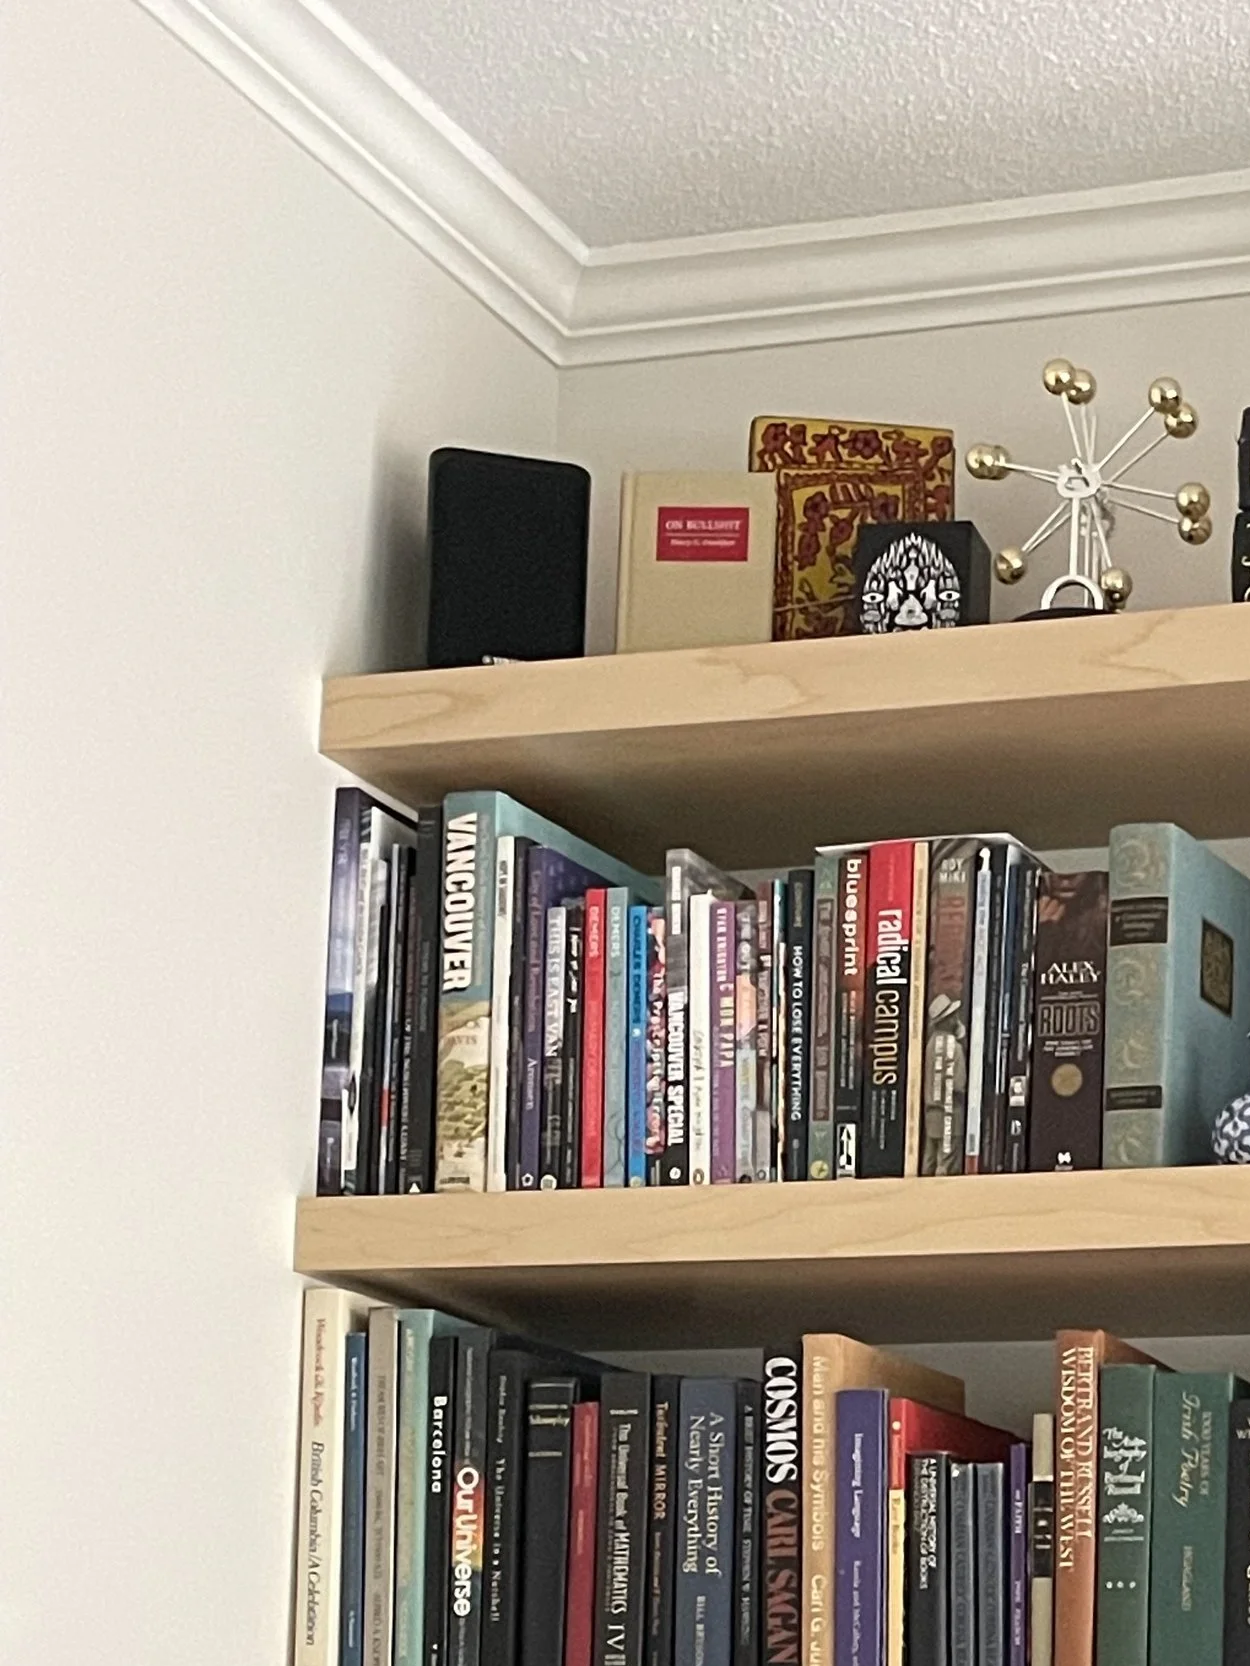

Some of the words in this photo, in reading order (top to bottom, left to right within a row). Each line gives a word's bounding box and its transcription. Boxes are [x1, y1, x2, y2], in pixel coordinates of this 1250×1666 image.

[442, 812, 478, 992] VANCOUVER
[843, 859, 861, 975] bluesprint
[610, 906, 620, 957] DEMERS
[876, 909, 908, 985] radical
[546, 957, 561, 971] IS
[791, 981, 802, 998] TO
[792, 946, 803, 978] HOW
[545, 976, 561, 1016] EAST
[791, 1001, 802, 1033] LOSE
[1038, 1002, 1100, 1037] ROOTS
[545, 1023, 560, 1056] VAN
[667, 991, 683, 1081] VANCOUVER
[869, 989, 897, 1084] campus
[790, 1036, 802, 1120] EVERYTHING
[667, 1085, 683, 1146] SPECIAL
[812, 1356, 829, 1395] Man
[1060, 1349, 1076, 1433] WISDOM
[1077, 1346, 1094, 1456] BERTRAND
[685, 1414, 703, 1472] Nearly
[709, 1412, 724, 1426] A
[764, 1357, 797, 1482] COSMOS
[812, 1398, 829, 1434] and
[1181, 1392, 1200, 1442] Irish
[431, 1397, 447, 1493] Barcelona
[707, 1432, 724, 1478] Short
[811, 1437, 828, 1465] his
[1060, 1436, 1075, 1460] OF
[653, 1464, 667, 1519] MIRROR
[1059, 1470, 1074, 1511] THE
[1077, 1462, 1092, 1539] RUSSELL
[1172, 1448, 1199, 1508] Poetry
[682, 1478, 703, 1573] Everything
[702, 1485, 723, 1550] History
[766, 1490, 798, 1565] CARL
[810, 1469, 828, 1550] Symbols
[1014, 1501, 1022, 1533] FAITH
[705, 1556, 722, 1578] of
[1058, 1514, 1074, 1570] WEST
[766, 1569, 797, 1663] SAGAN
[809, 1574, 826, 1612] Carl
[810, 1617, 825, 1637] G.
